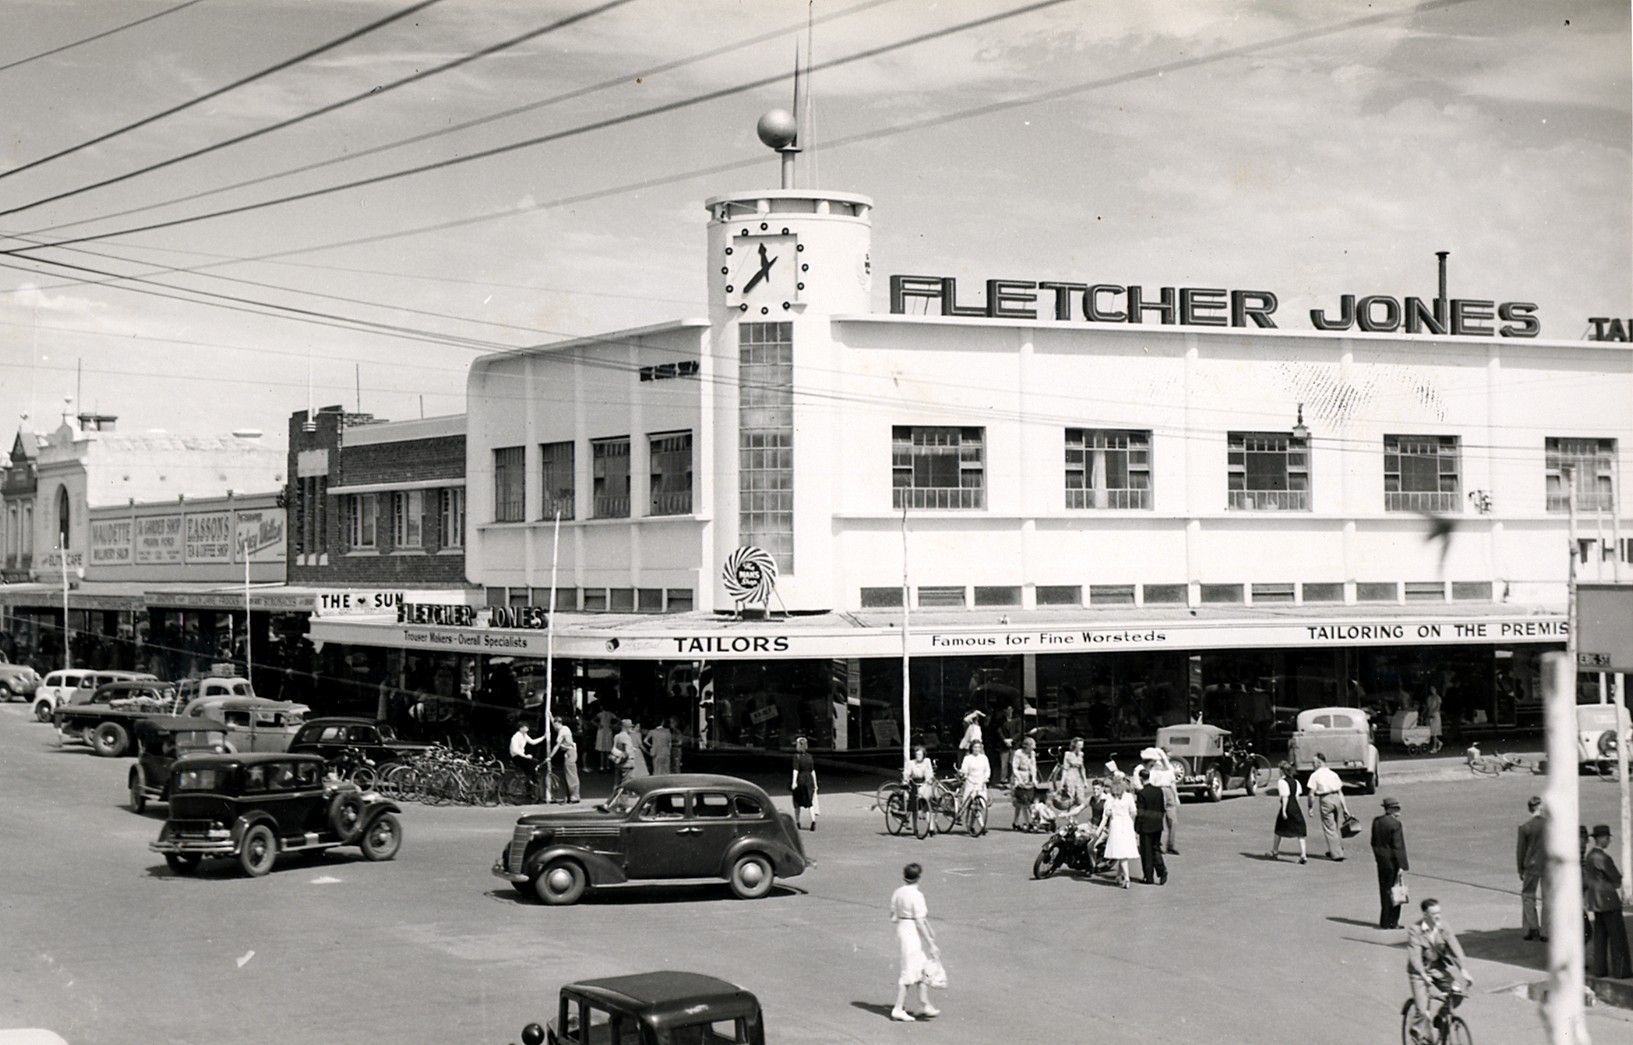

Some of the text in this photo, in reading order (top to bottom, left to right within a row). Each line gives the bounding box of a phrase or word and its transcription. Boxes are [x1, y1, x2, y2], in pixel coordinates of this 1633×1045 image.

[889, 275, 1542, 338] FLETCHER JONES
[1588, 317, 1633, 342] TA
[1577, 538, 1633, 564] TH
[321, 594, 350, 608] THE
[374, 593, 404, 608] SUN
[398, 603, 548, 629] FLETCHER JONES
[404, 630, 427, 642] Trouser
[429, 632, 453, 643] Makers
[458, 634, 481, 645] Overall
[484, 634, 528, 649] Specialists
[932, 631, 1167, 647] Famous for Fine Worsteds
[1307, 625, 1404, 639] TAILORING
[1417, 624, 1442, 638] ON
[1454, 624, 1487, 637] THE
[673, 636, 789, 653] TAILORS
